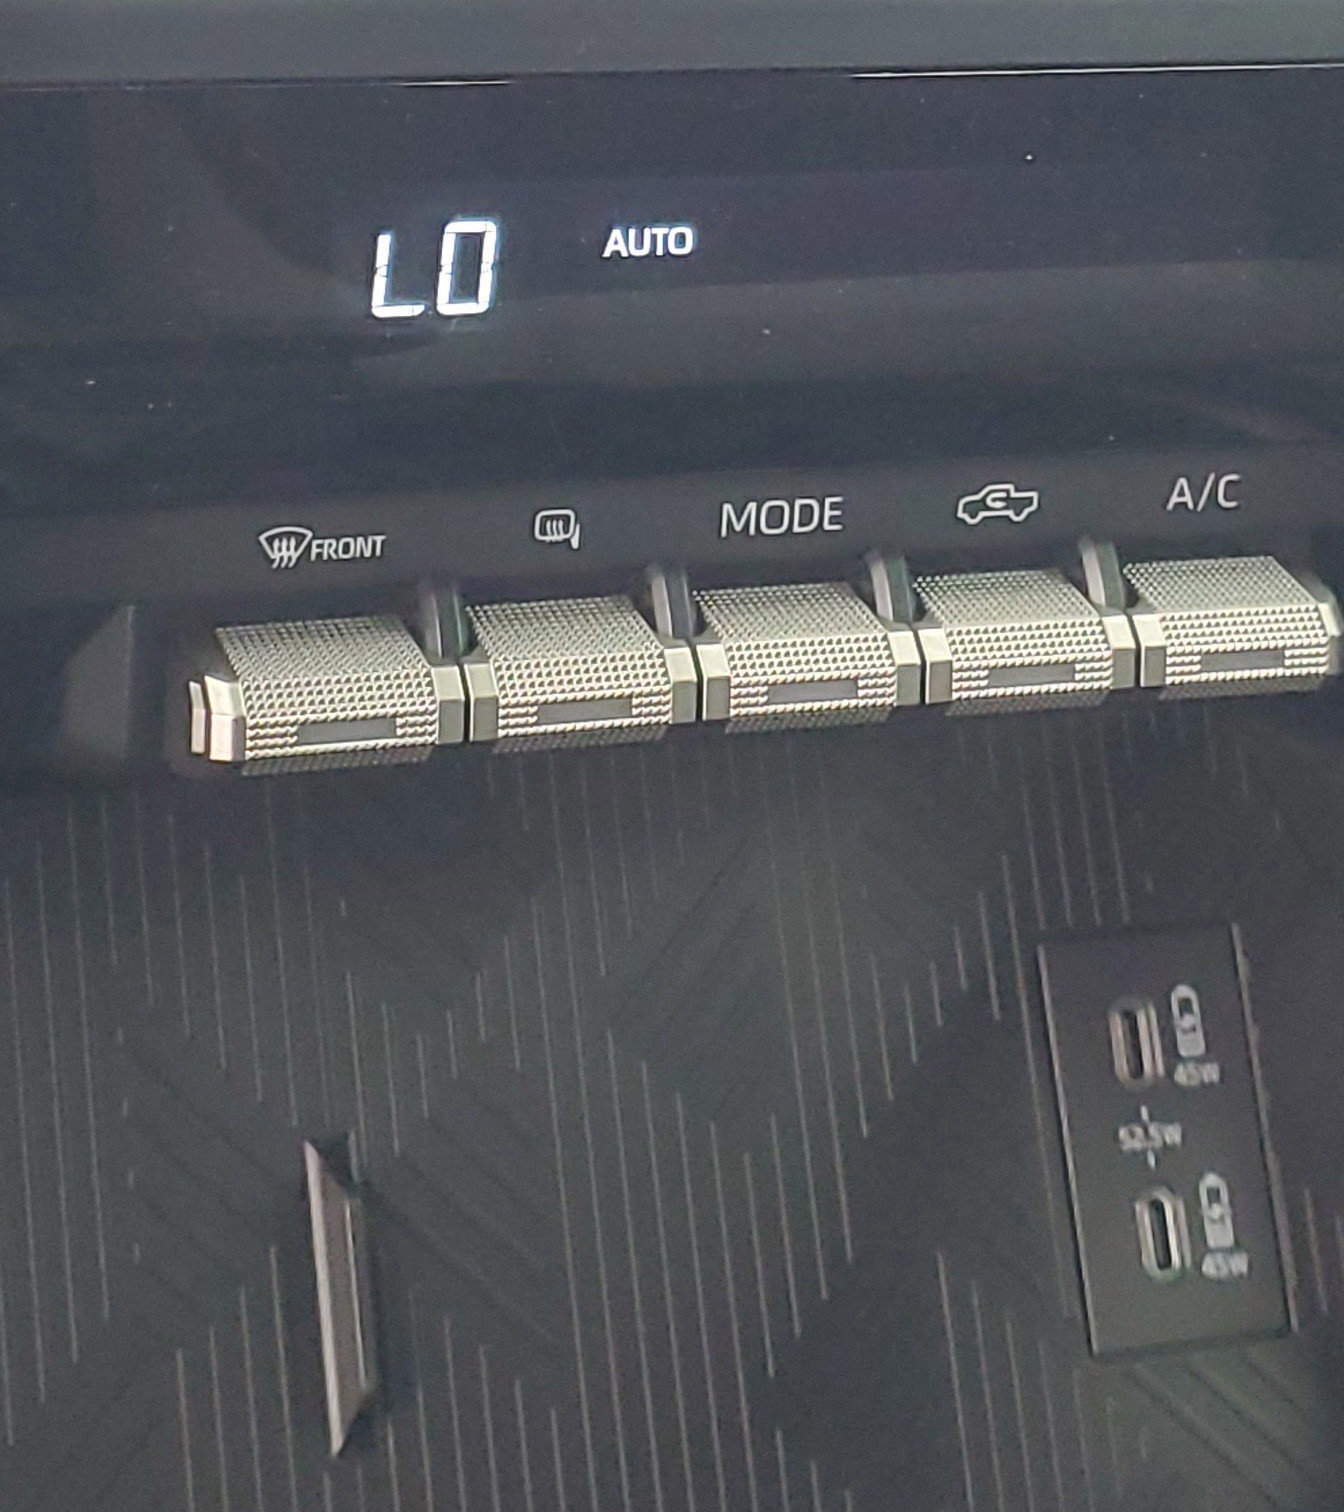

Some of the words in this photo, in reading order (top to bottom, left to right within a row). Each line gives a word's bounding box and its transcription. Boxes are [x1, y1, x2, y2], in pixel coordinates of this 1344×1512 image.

[602, 226, 694, 259] AUTO
[1166, 473, 1242, 512] A/C
[719, 496, 844, 538] MODE
[310, 534, 387, 561] FRONT
